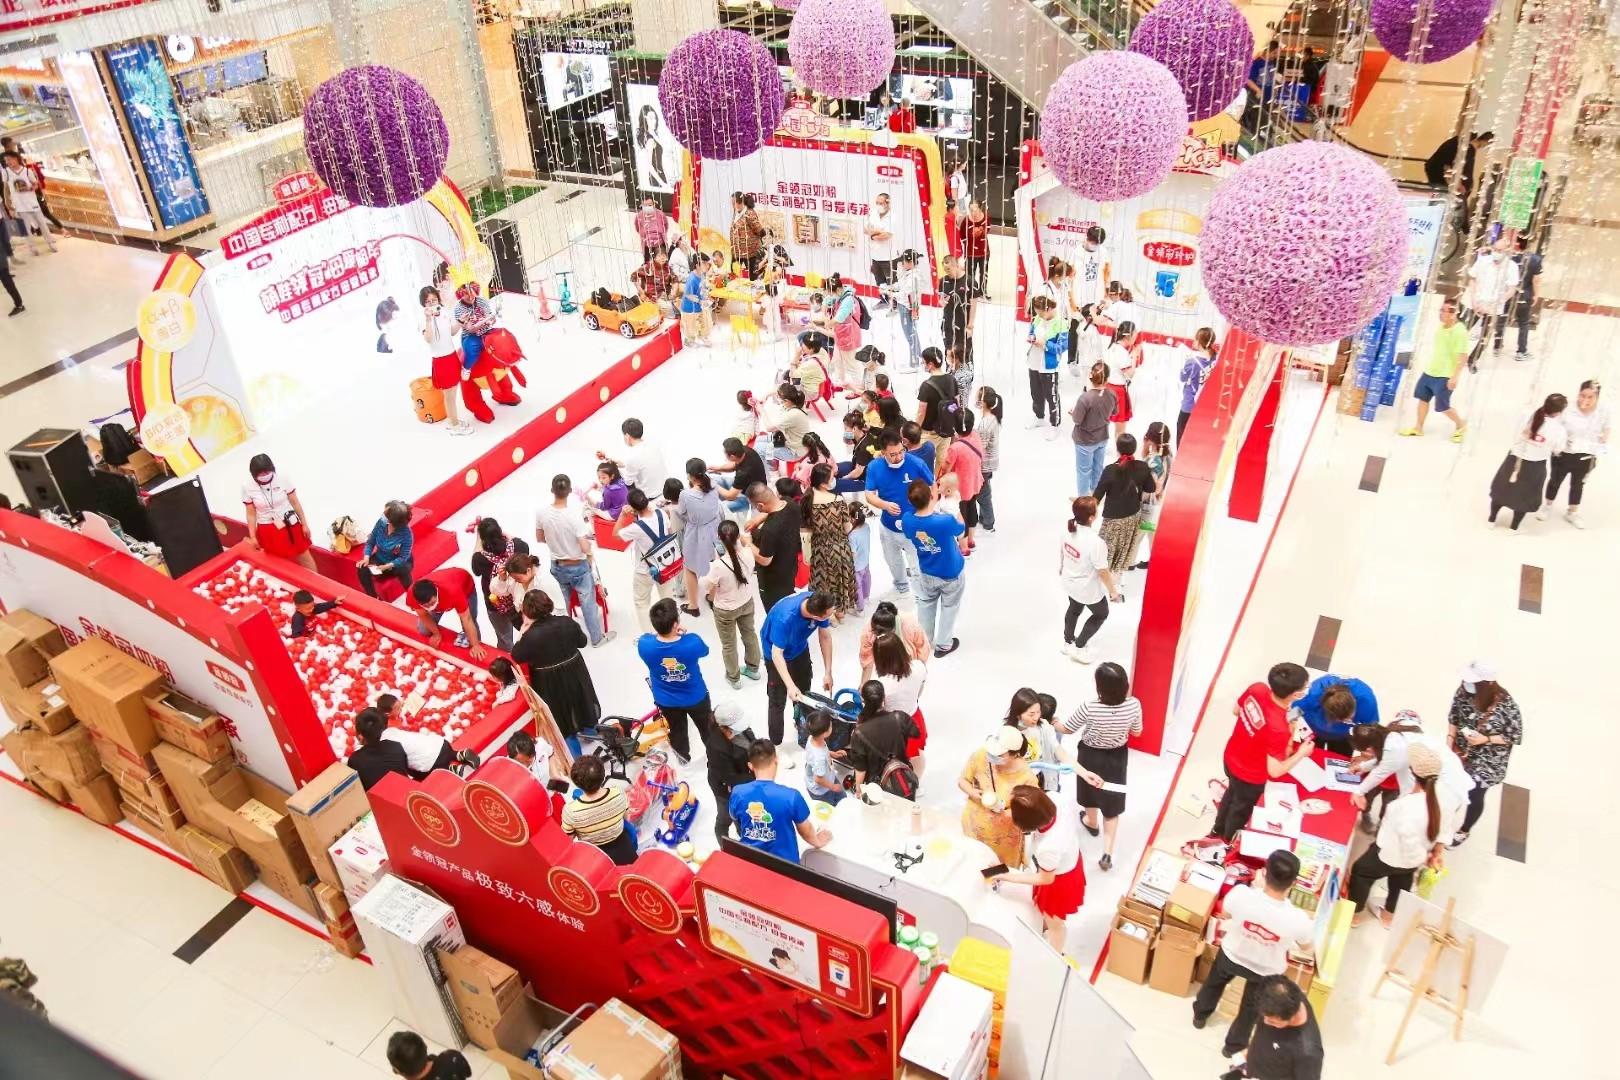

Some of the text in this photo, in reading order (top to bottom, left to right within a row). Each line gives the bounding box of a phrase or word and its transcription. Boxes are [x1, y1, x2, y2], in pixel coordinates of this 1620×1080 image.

[776, 181, 837, 199] 金领冠奶粉
[746, 191, 817, 211] 中国专利配方
[226, 203, 318, 255] 中国专利配方
